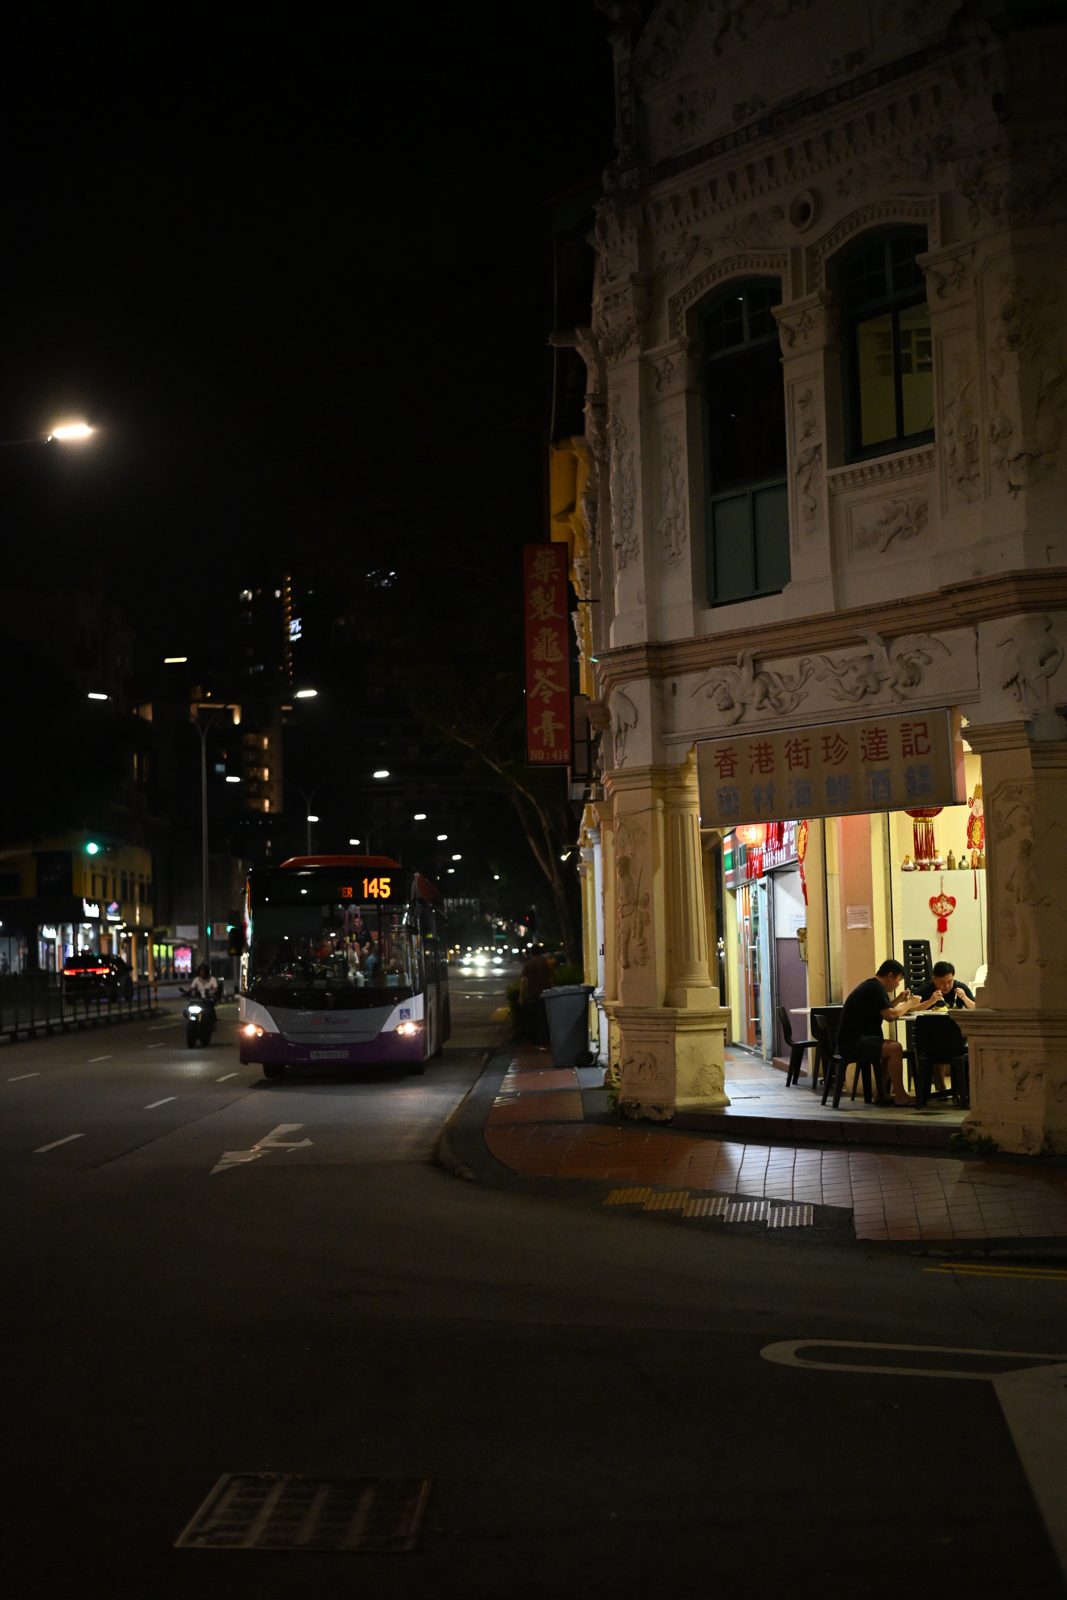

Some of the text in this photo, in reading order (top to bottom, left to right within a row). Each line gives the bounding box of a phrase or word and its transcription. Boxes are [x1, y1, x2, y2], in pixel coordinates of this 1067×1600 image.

[714, 721, 931, 779] 香港街珍達記
[362, 877, 391, 899] 145
